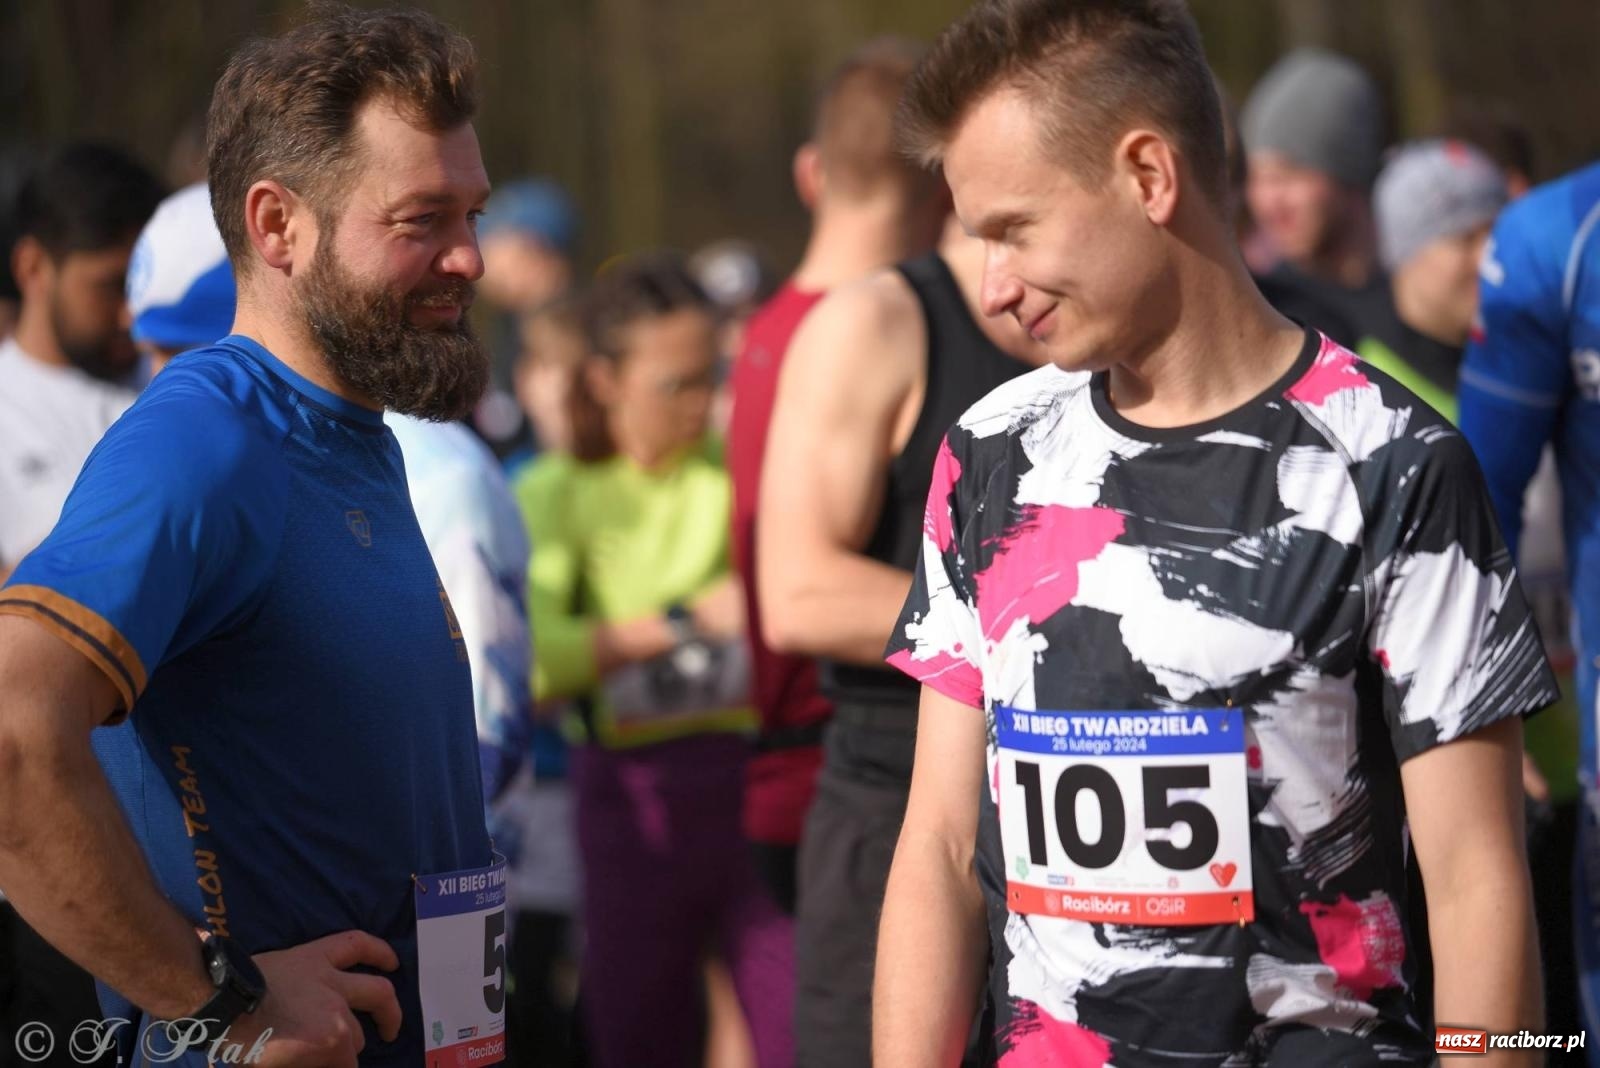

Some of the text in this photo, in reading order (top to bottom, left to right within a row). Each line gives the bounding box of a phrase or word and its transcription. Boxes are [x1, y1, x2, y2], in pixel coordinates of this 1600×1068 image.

[1012, 713, 1209, 736] XII BIEG TWARDZIELA
[1052, 737, 1147, 755] 25 lutego 2024
[171, 745, 209, 837] TEAM
[1015, 760, 1219, 870] 105
[438, 878, 457, 896] XII
[459, 873, 486, 893] BIEG
[1062, 895, 1131, 914] Racibórz
[1145, 897, 1186, 914] OSiR
